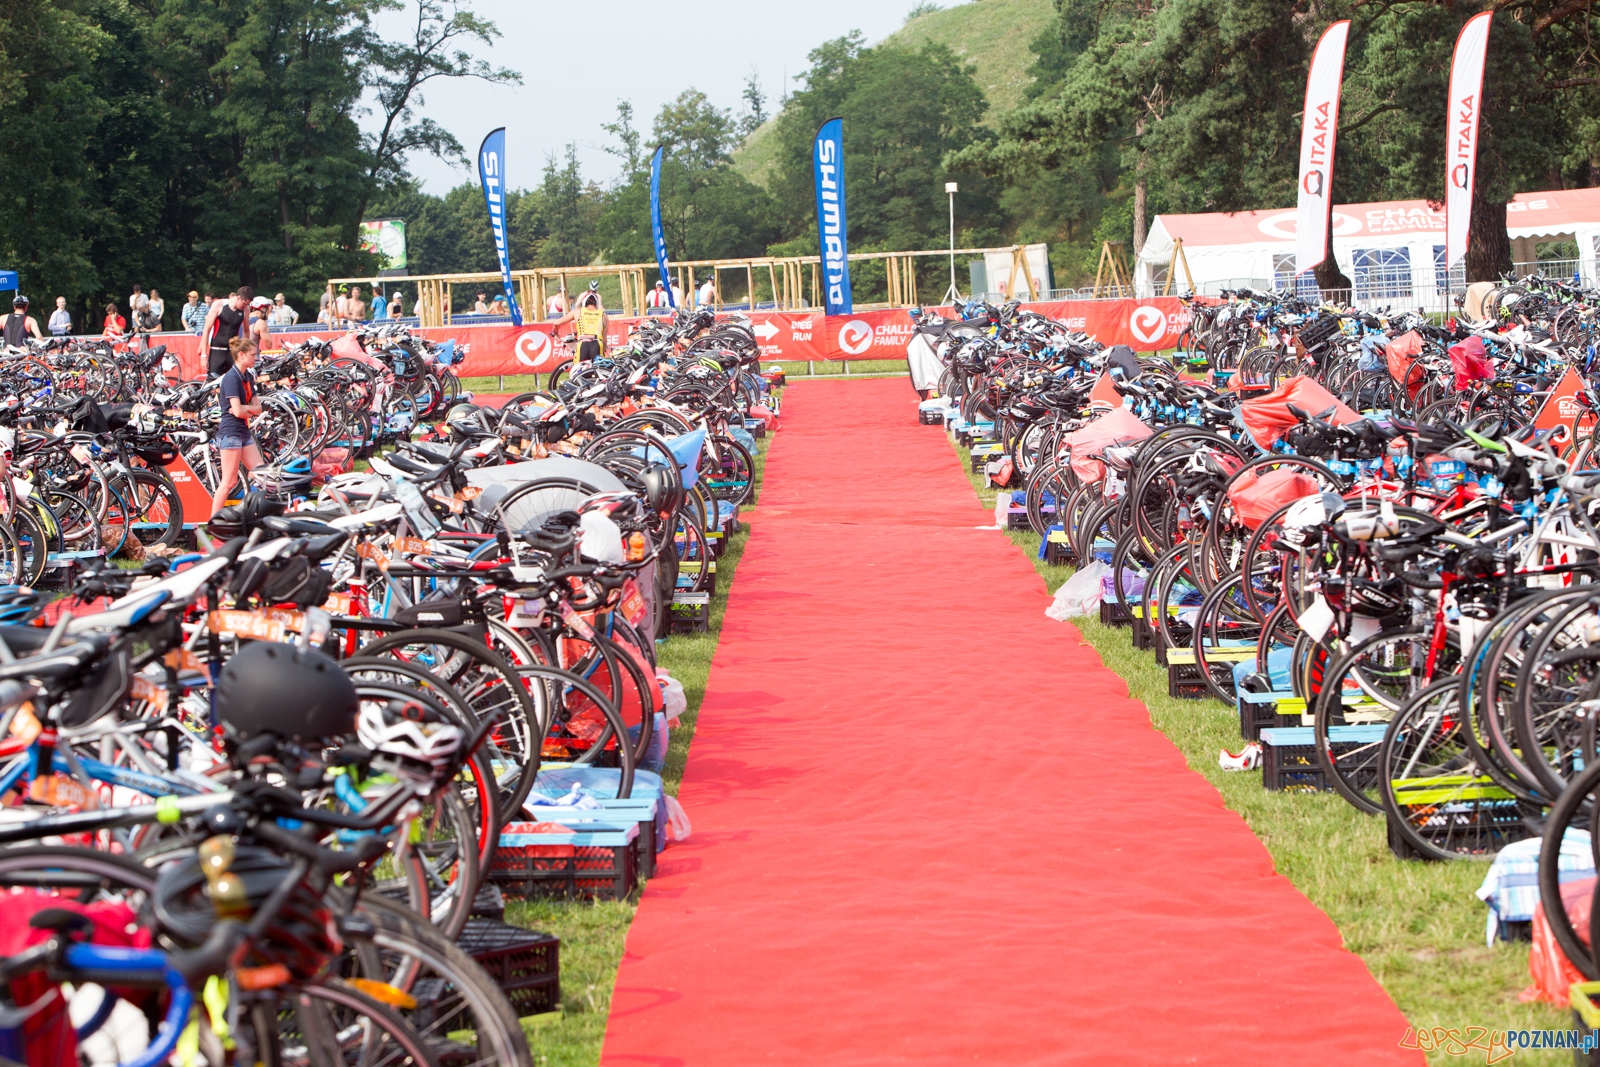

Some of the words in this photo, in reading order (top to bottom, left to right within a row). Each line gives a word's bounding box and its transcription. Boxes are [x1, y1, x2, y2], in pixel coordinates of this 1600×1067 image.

[1310, 101, 1331, 165] ITAKA
[1457, 94, 1474, 158] ITAKA
[818, 139, 844, 305] SHIMANO
[792, 331, 812, 341] RUN
[874, 335, 907, 346] FAMILY
[408, 540, 423, 552] 925
